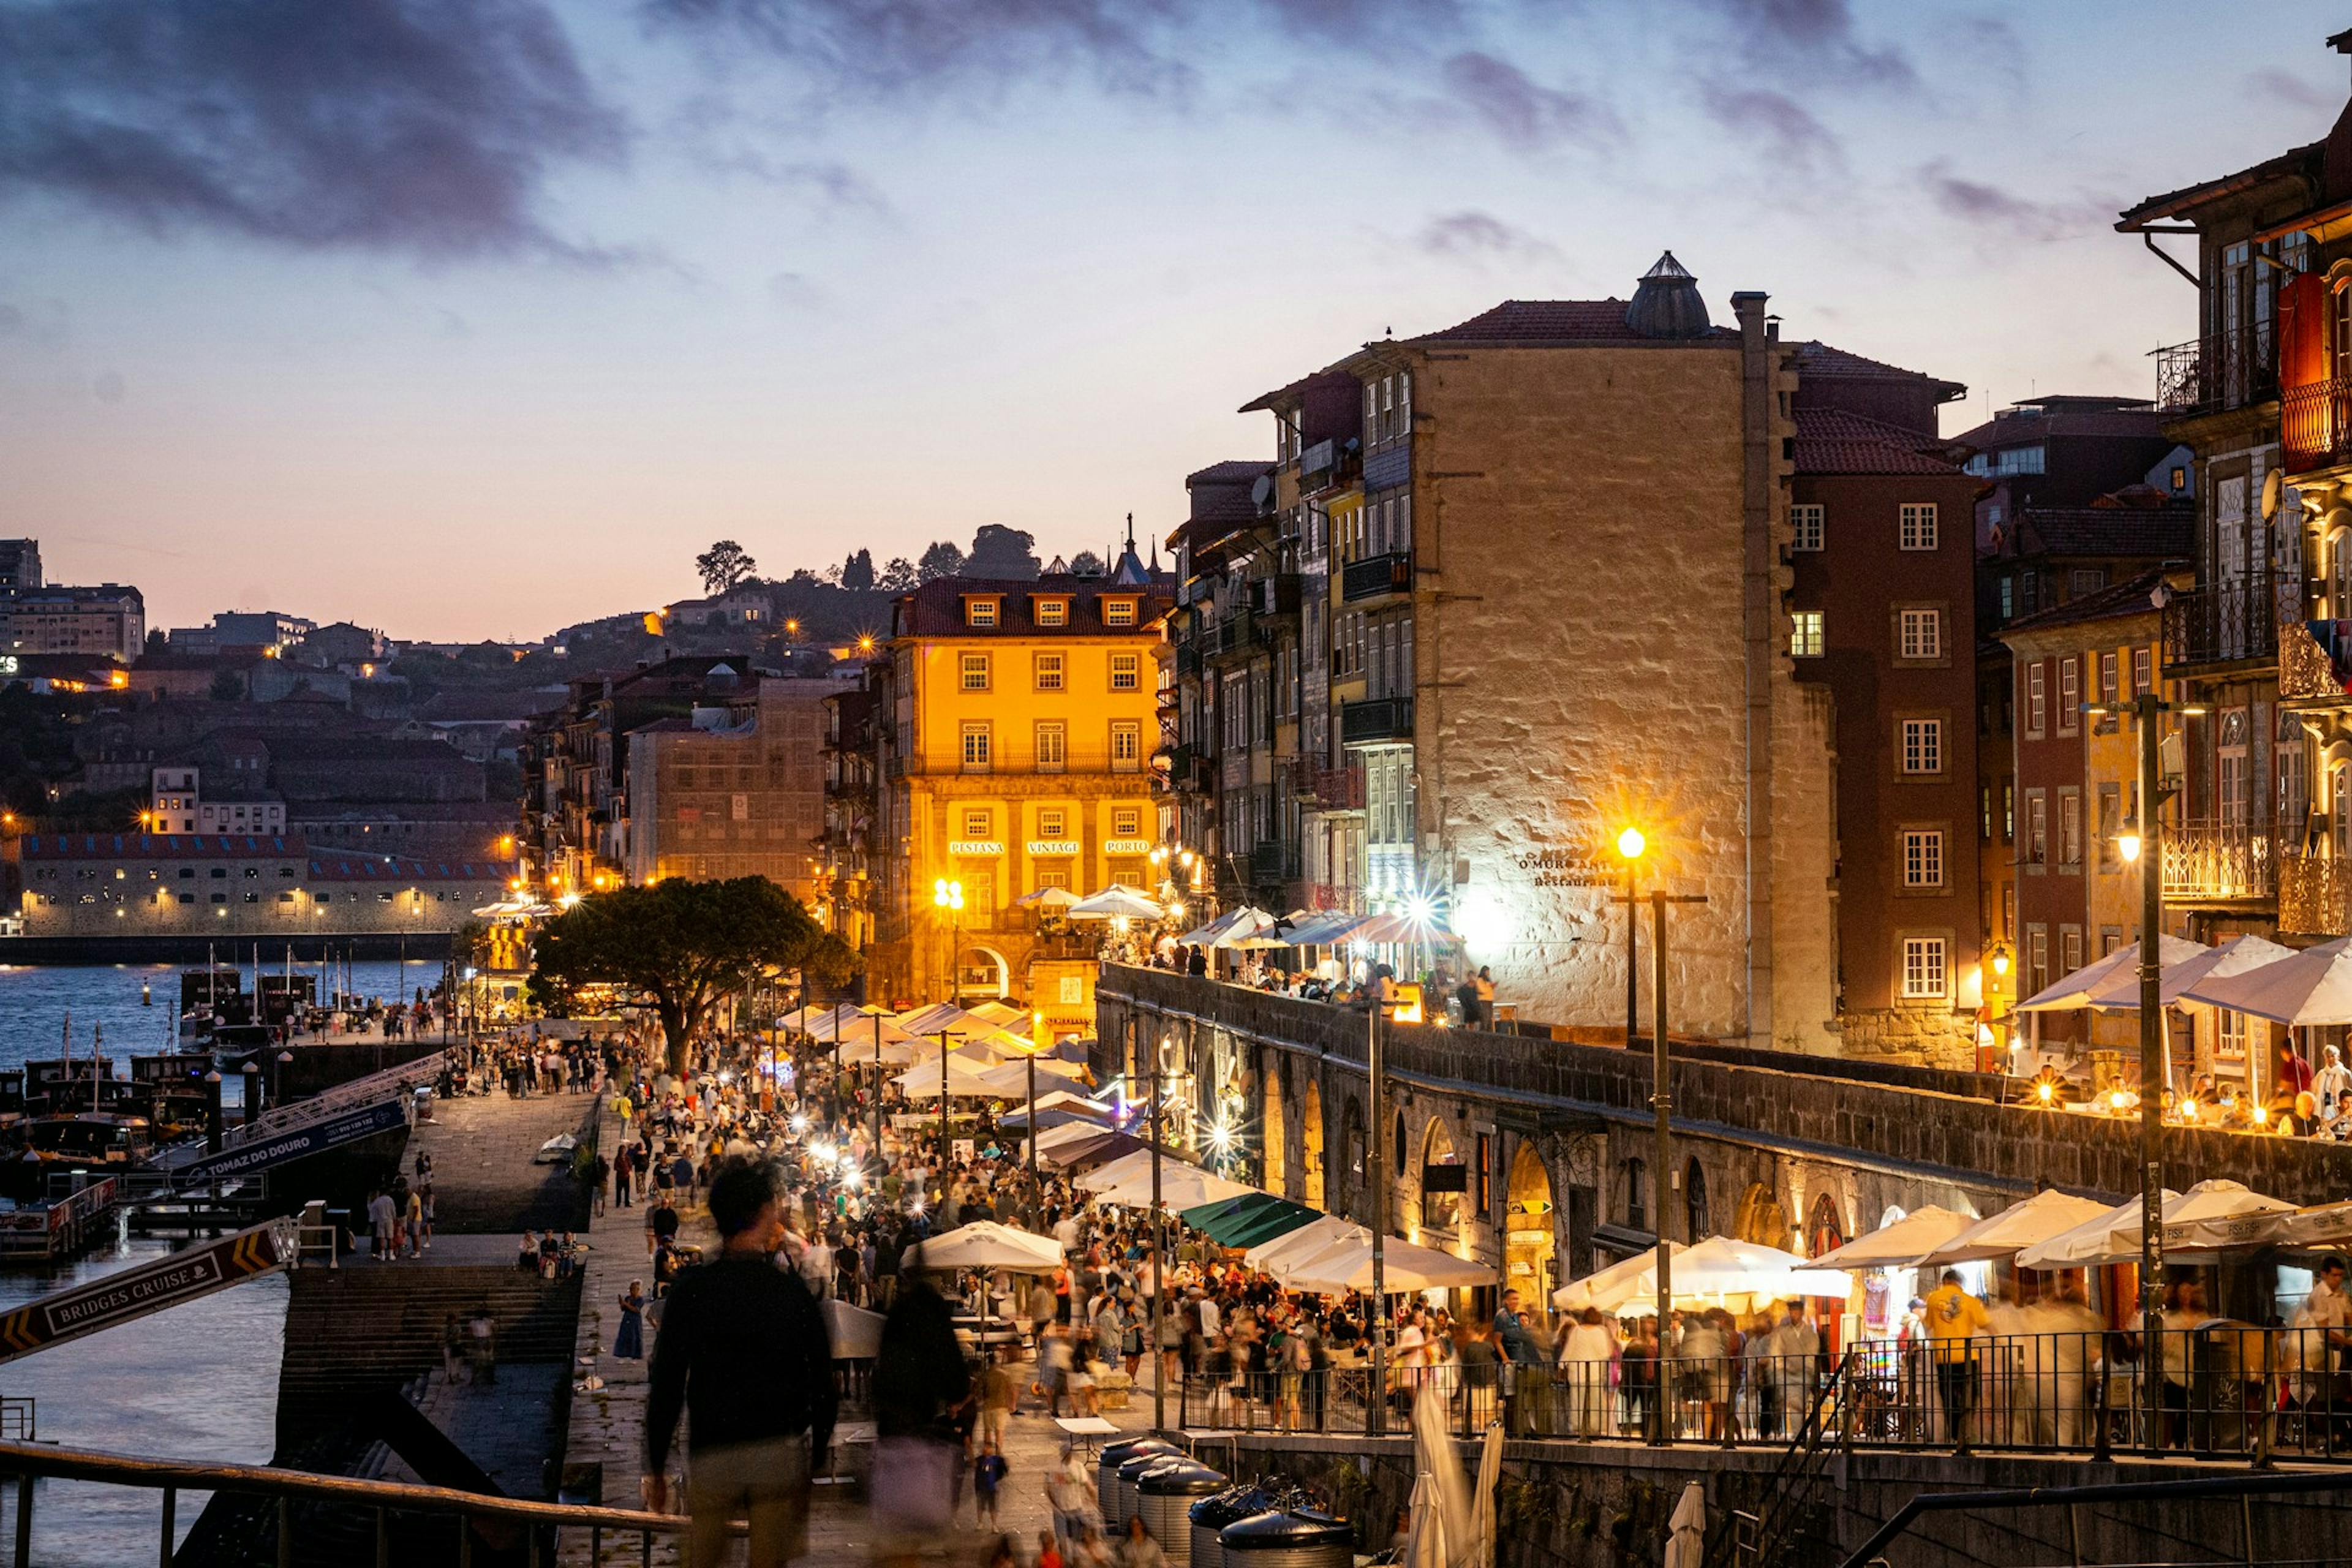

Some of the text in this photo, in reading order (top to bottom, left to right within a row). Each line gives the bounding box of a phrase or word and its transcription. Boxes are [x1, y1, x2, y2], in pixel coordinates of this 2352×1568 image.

[951, 842, 1148, 853] PESTANA VINTAGE PORTO
[208, 1137, 310, 1175] TOMAZ DO DOURO
[60, 1270, 190, 1323] BRIDGES CRUISE
